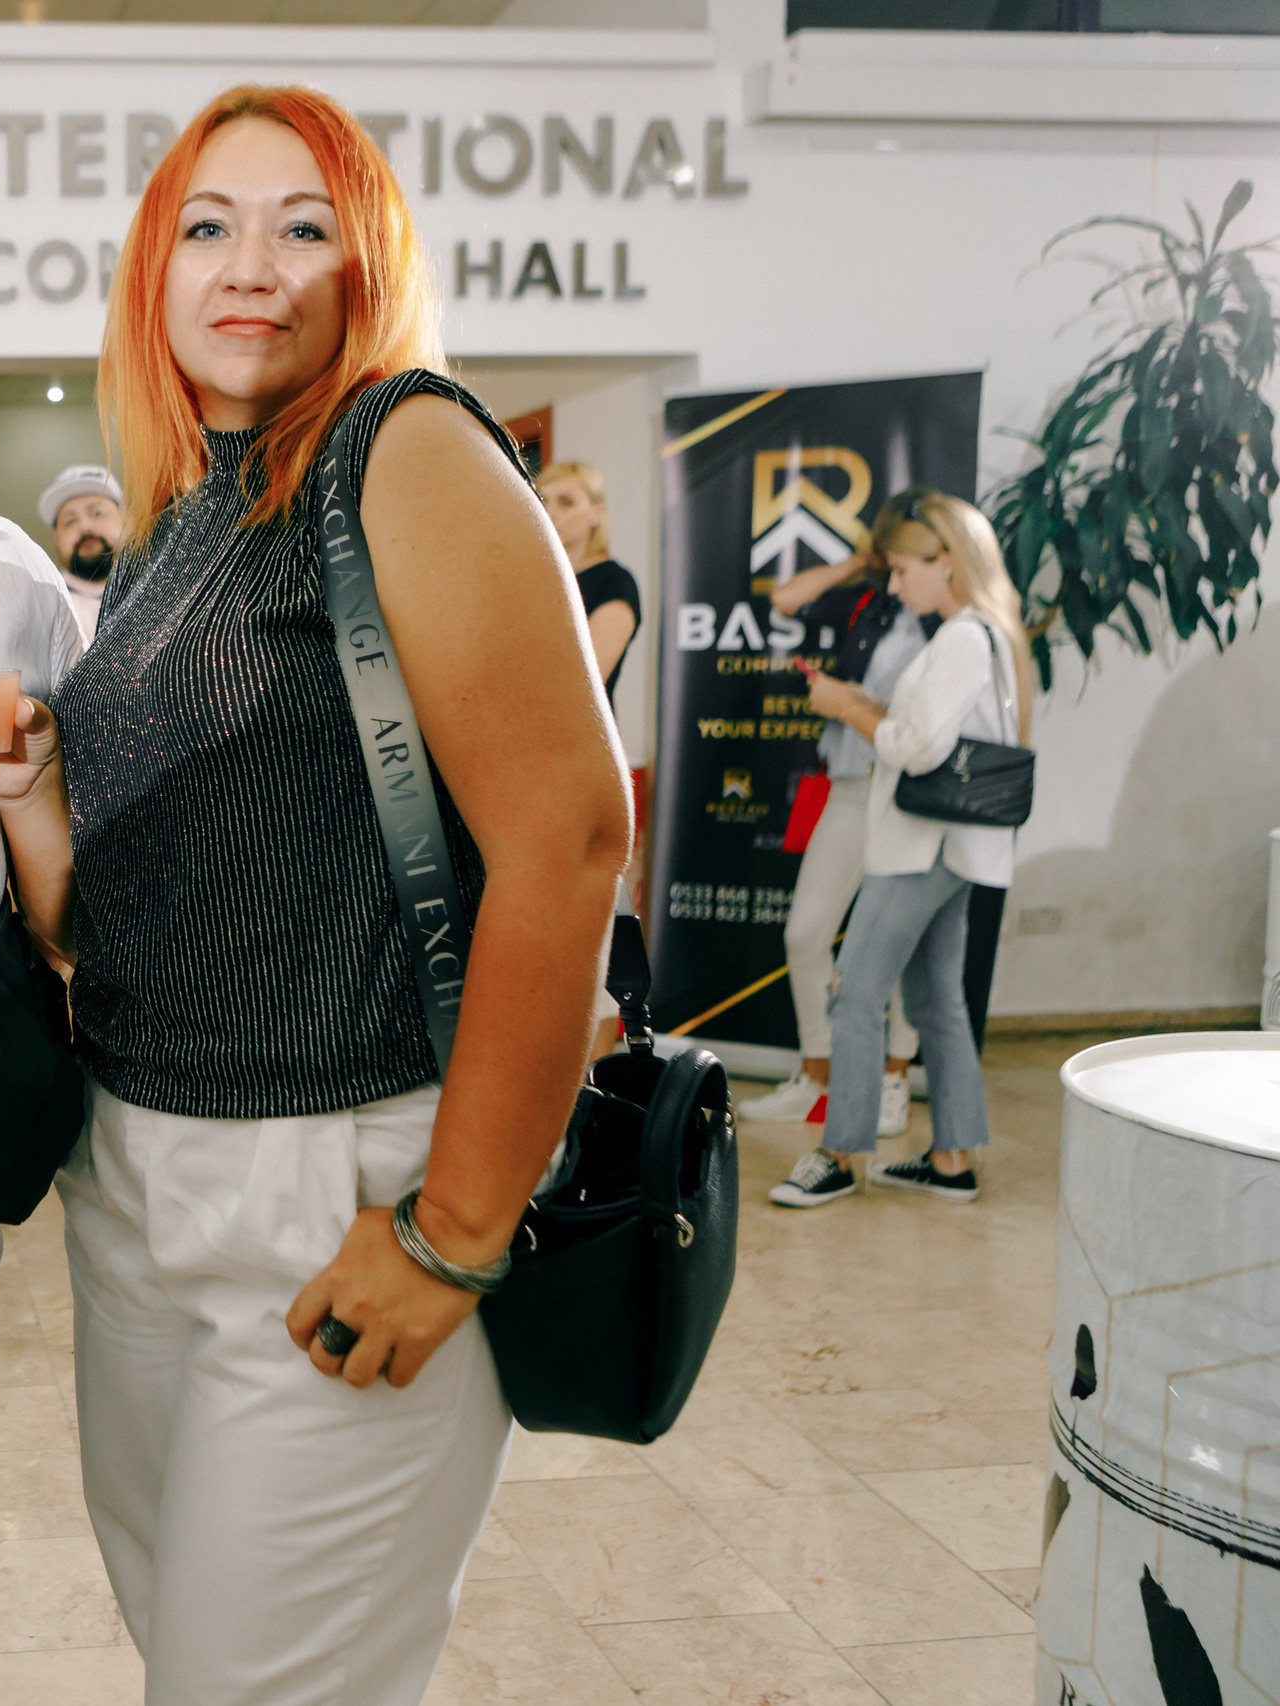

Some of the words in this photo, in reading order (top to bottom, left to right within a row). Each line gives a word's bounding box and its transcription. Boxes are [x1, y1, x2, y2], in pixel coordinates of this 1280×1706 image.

[454, 240, 646, 298] HALL
[697, 718, 756, 739] YOUR
[760, 720, 824, 740] EXPEC
